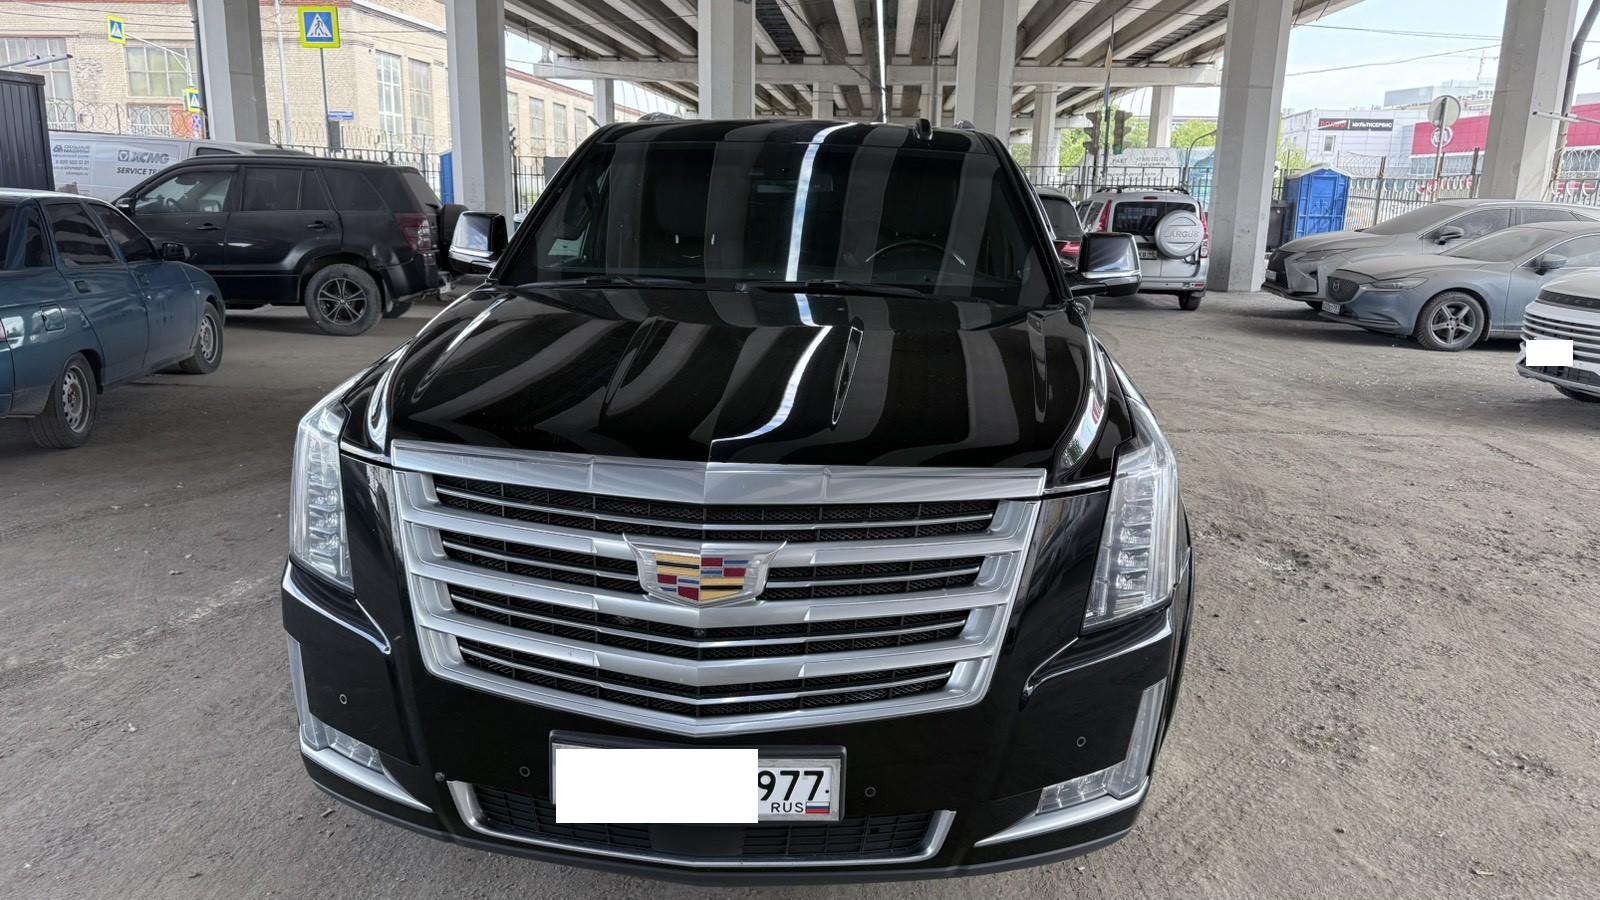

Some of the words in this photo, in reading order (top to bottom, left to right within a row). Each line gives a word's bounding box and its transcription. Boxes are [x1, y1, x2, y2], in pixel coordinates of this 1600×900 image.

[130, 151, 170, 164] XCMG
[116, 166, 148, 175] SERVICE
[1169, 230, 1200, 238] ARGUS
[758, 770, 824, 801] 977
[771, 802, 804, 813] RUS
